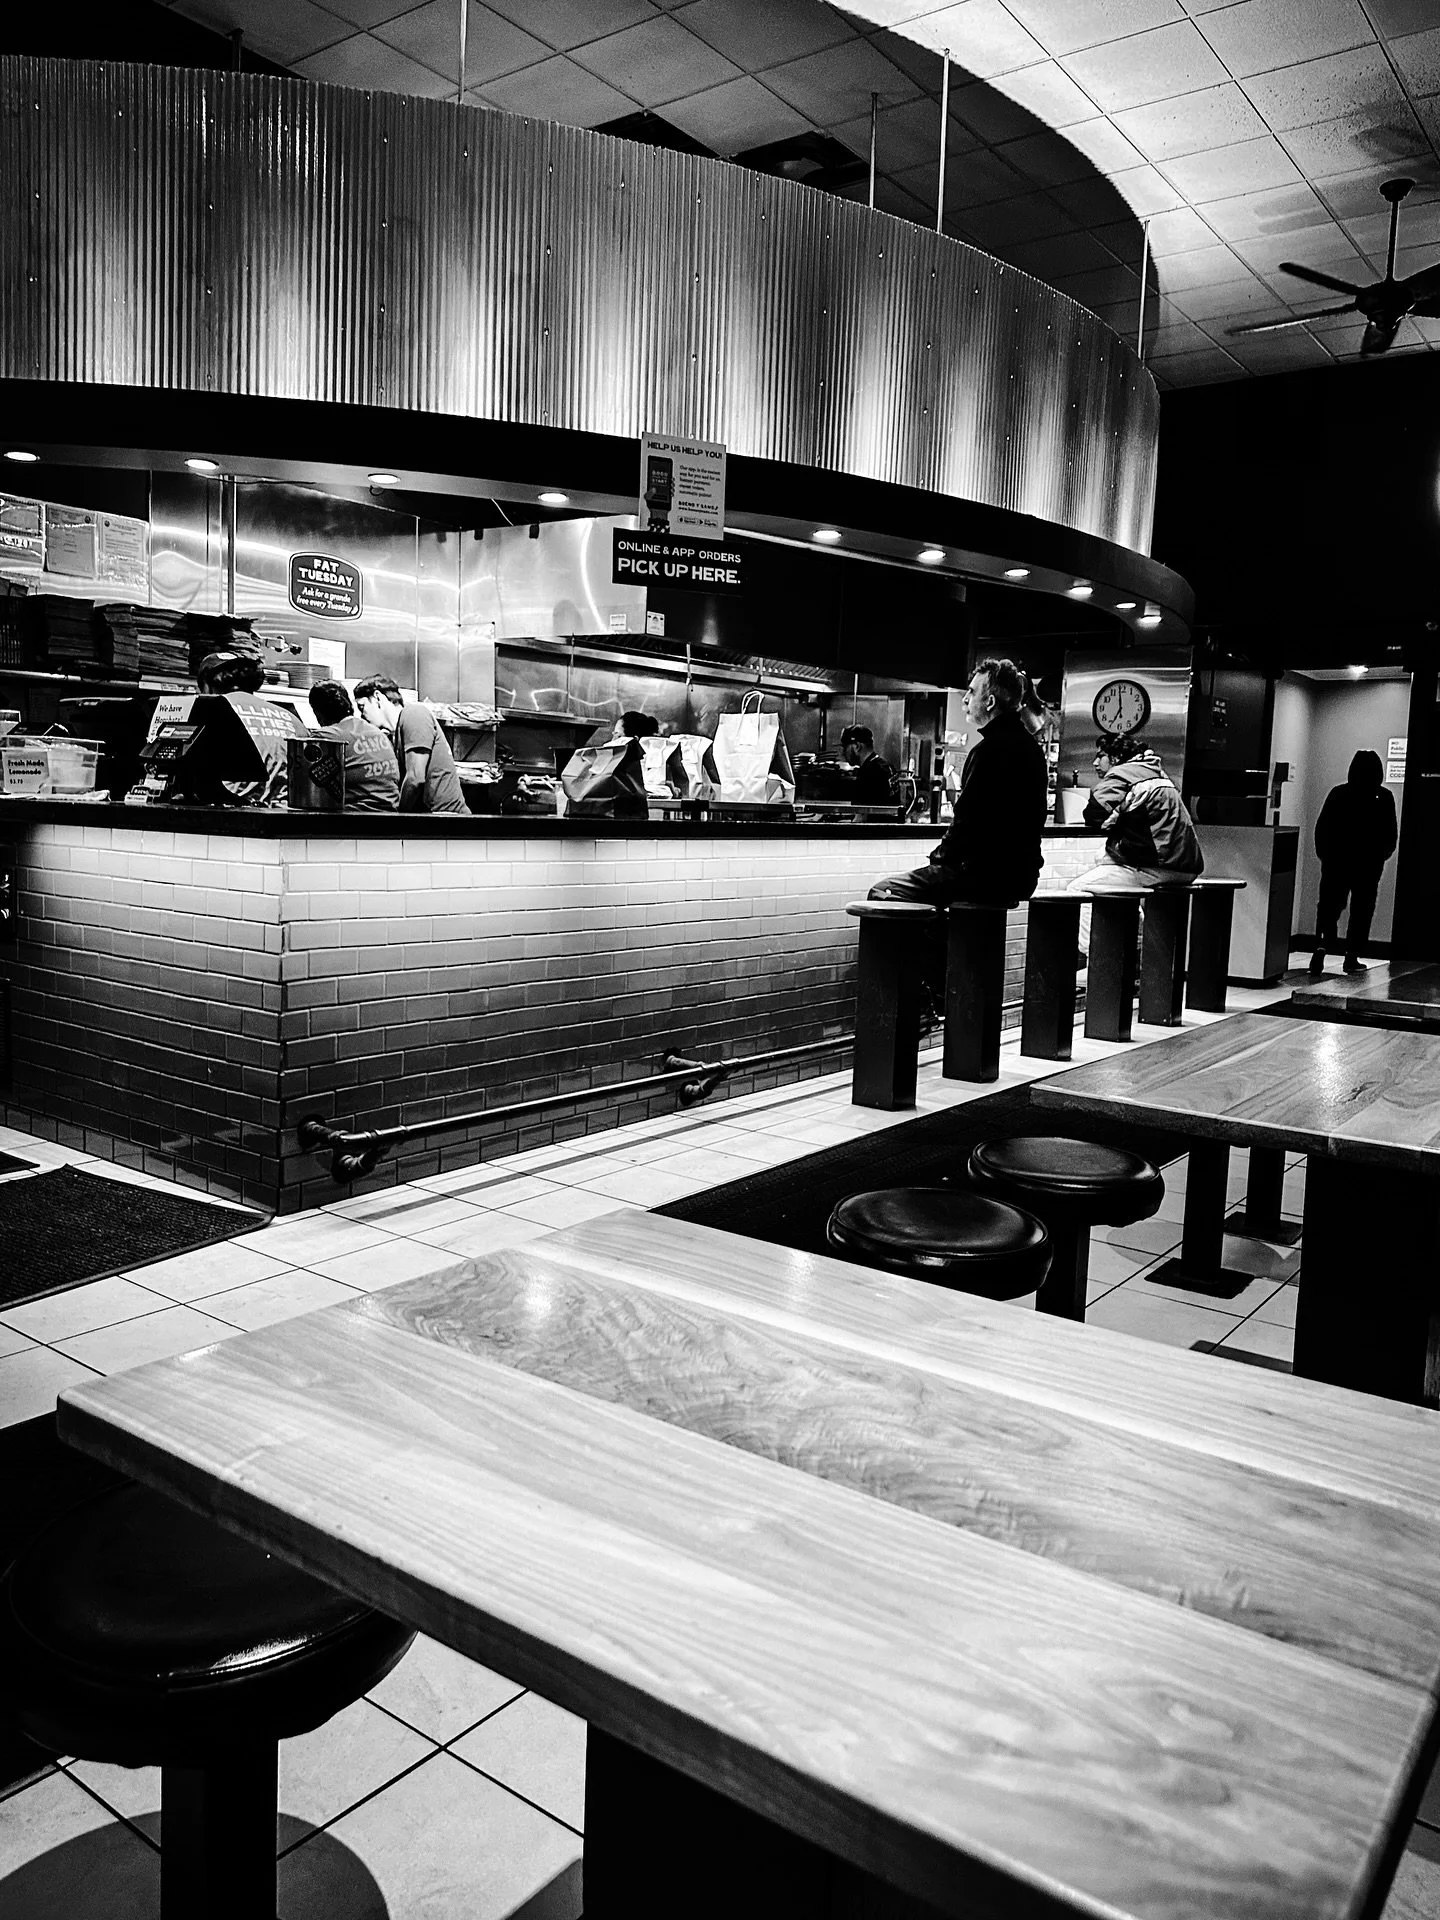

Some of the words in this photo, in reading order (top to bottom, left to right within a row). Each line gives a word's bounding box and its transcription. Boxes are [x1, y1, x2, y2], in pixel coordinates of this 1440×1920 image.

[647, 441, 669, 450] HELP
[671, 444, 681, 453] US
[682, 446, 703, 456] HELP
[705, 450, 722, 459] YOU!
[618, 541, 660, 554] ONLINE
[662, 546, 670, 555] &
[672, 547, 695, 557] APP
[699, 550, 741, 563] ORDERS
[313, 558, 340, 573] FAT
[618, 557, 660, 576] PICK
[664, 562, 689, 578] UP
[691, 565, 741, 584] HERE.
[298, 567, 354, 587] TUESDAY
[302, 586, 315, 597] Ask
[315, 588, 324, 598] for
[297, 595, 309, 605] free
[310, 600, 326, 609] every
[1134, 694, 1140, 702] 2
[160, 704, 168, 712] We
[1137, 703, 1143, 711] 3
[1133, 713, 1139, 721] 4
[1126, 720, 1132, 728] 5
